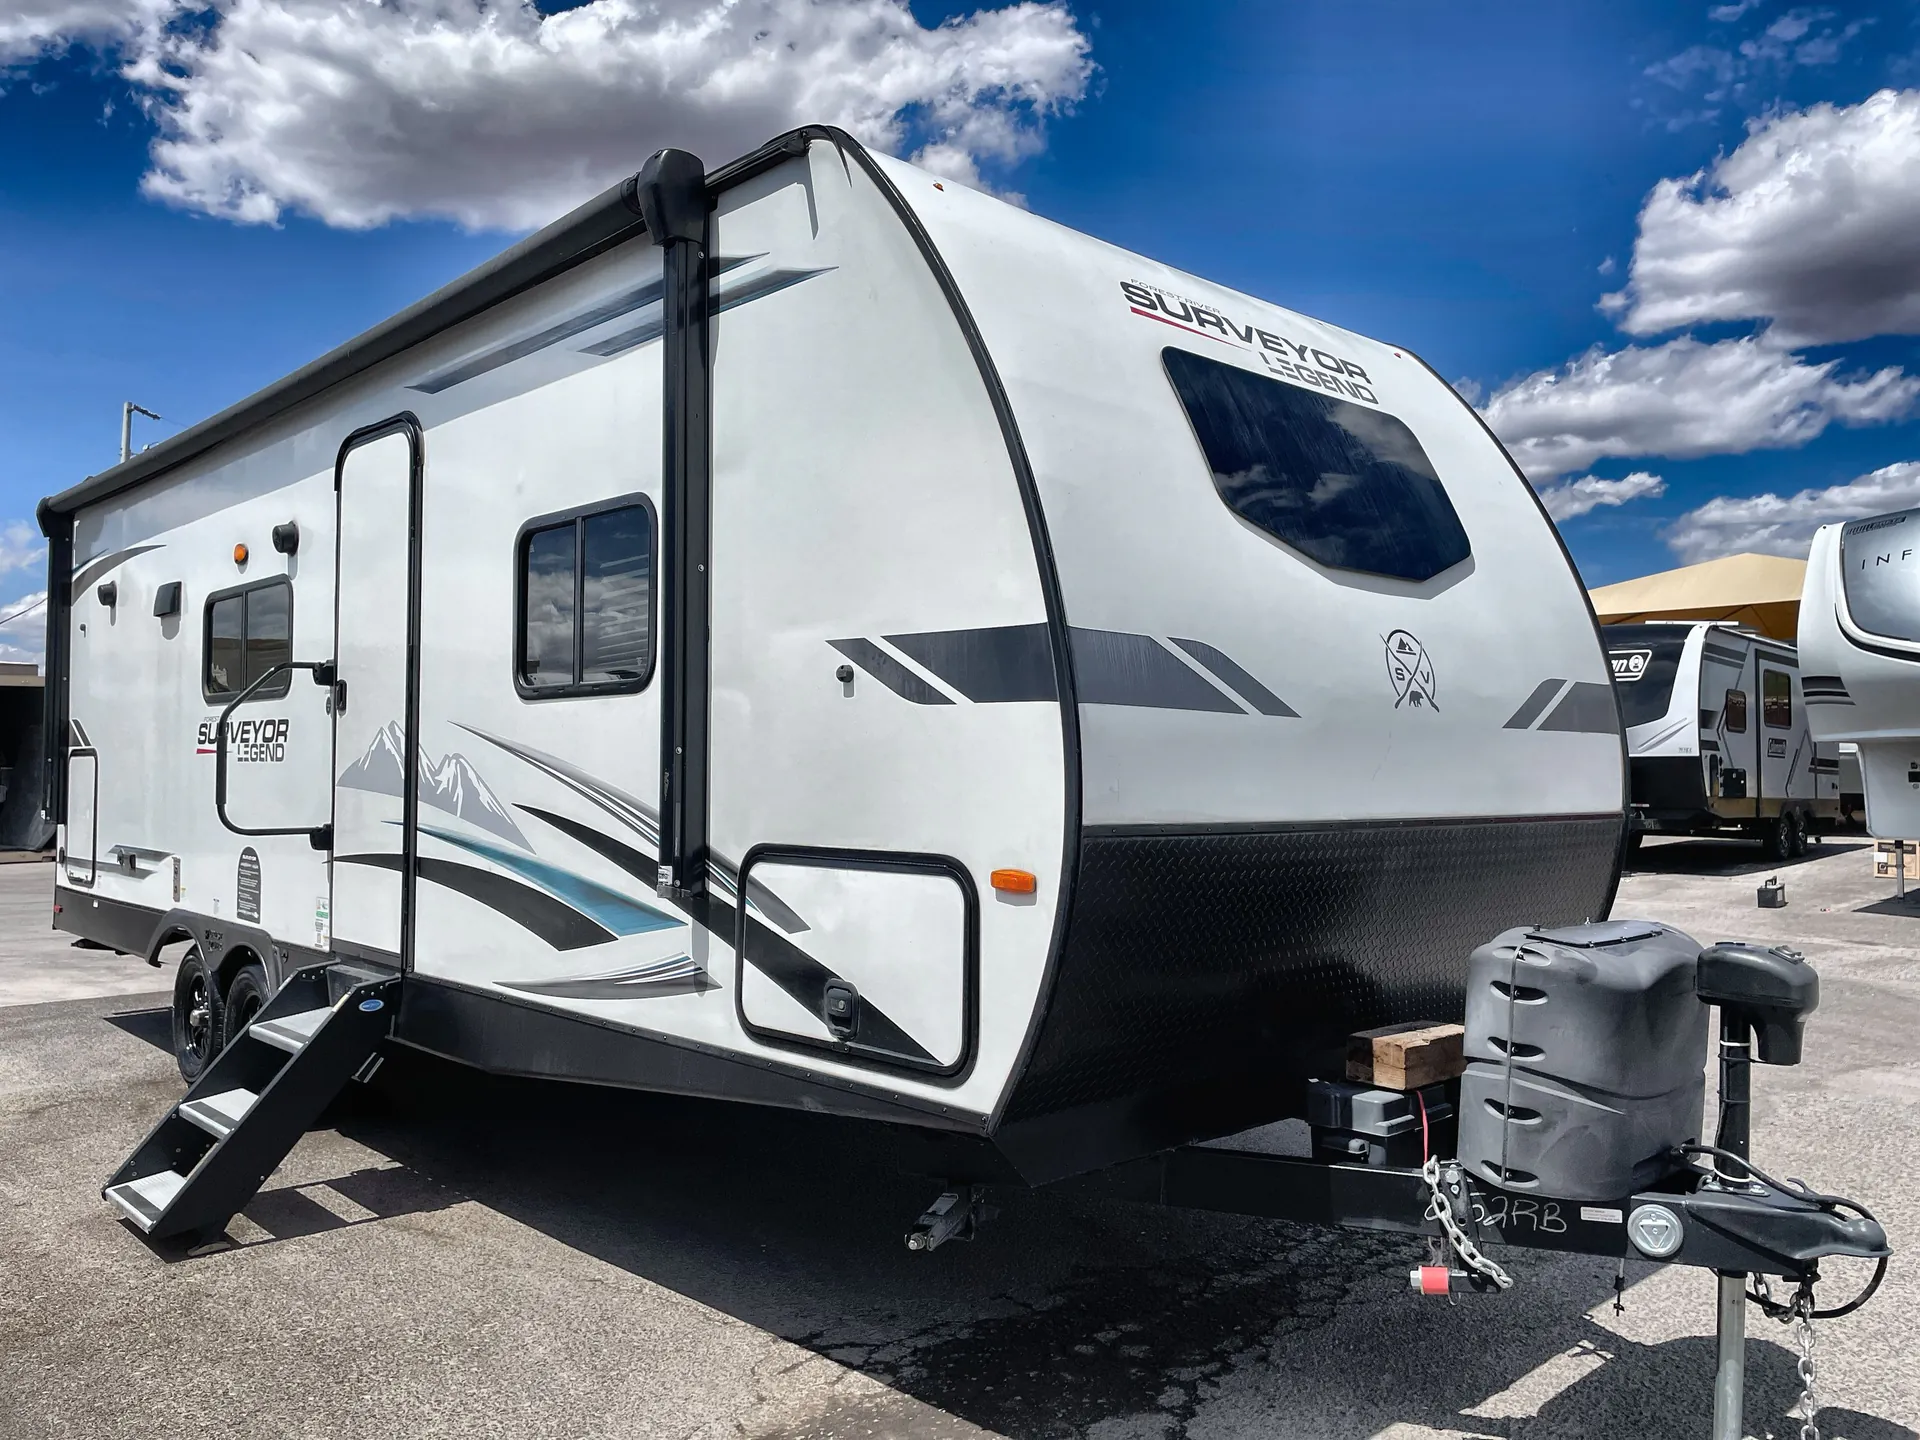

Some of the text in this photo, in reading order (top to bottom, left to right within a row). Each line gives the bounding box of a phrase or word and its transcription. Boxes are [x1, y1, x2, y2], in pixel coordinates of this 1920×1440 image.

[1131, 278, 1221, 315] FOREST RIVER
[1119, 280, 1373, 385] SURVEYOR
[1258, 351, 1380, 405] LEGEND
[1861, 548, 1913, 570] INF
[1394, 667, 1430, 684] S V
[237, 743, 285, 762] LEGEND
